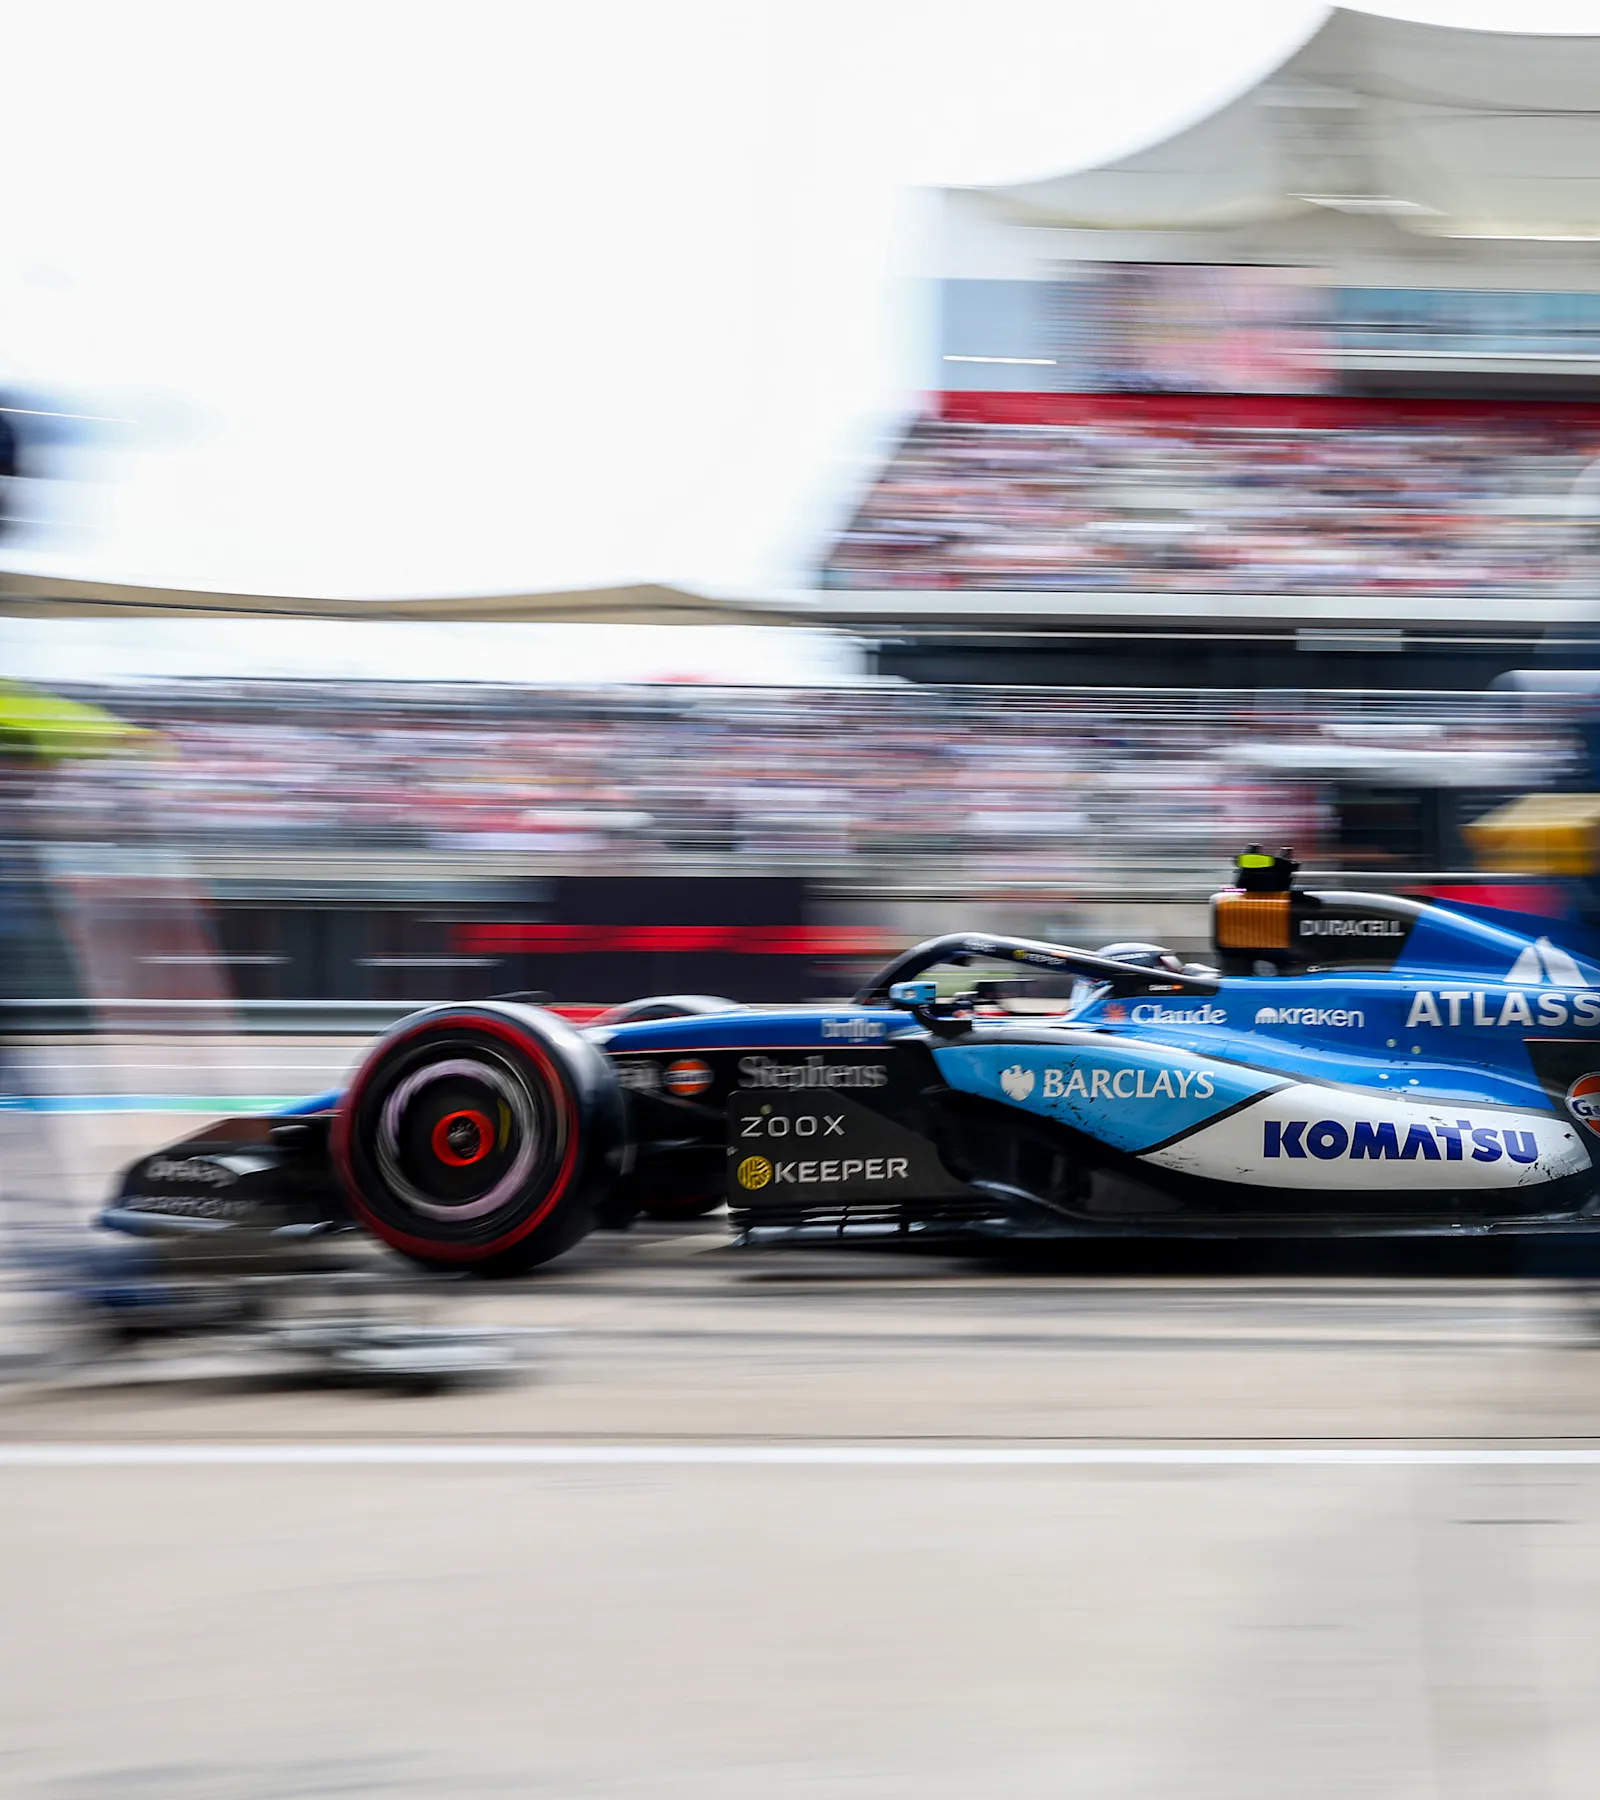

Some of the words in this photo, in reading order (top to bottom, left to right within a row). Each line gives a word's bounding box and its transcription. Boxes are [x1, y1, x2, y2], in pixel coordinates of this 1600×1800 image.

[1300, 920, 1405, 936] DURACELL
[1131, 1004, 1227, 1025] Claude
[1279, 1007, 1364, 1027] kraken
[738, 1056, 887, 1091] Stephens
[1043, 1069, 1215, 1099] BARCLAYS
[741, 1115, 846, 1137] ZOOX
[1264, 1119, 1539, 1164] KOMATSU
[775, 1157, 909, 1184] KEEPER
